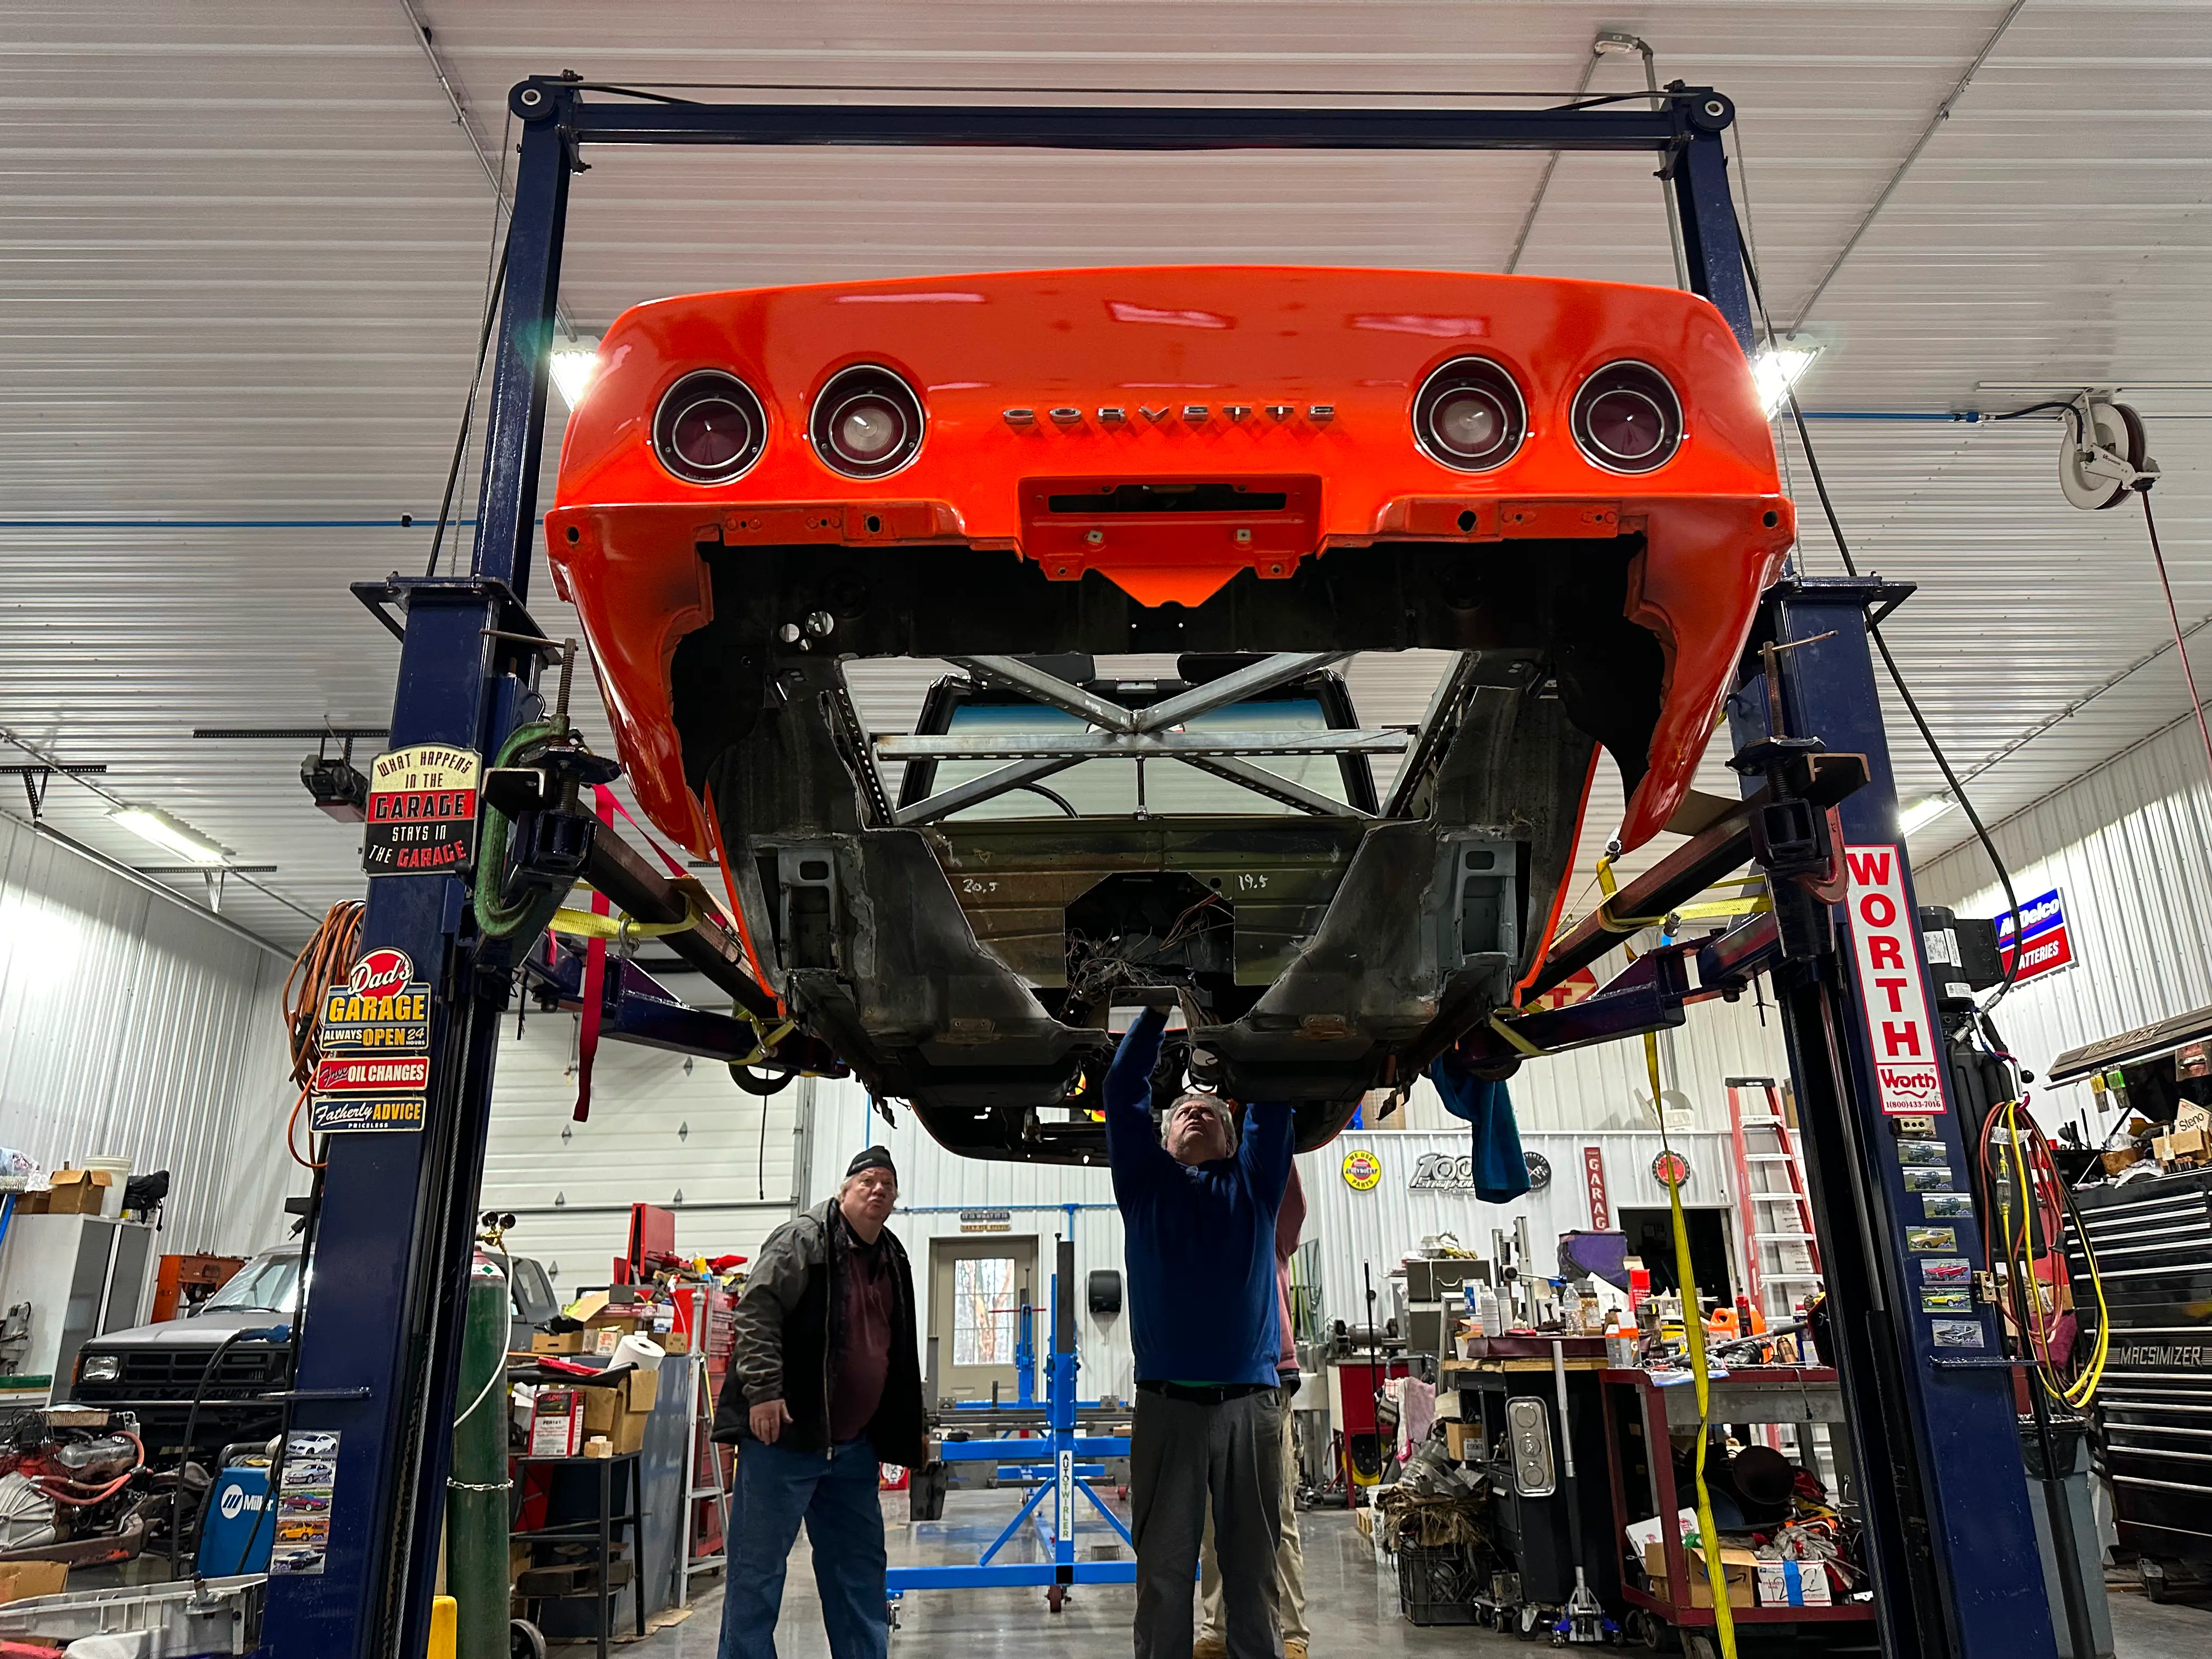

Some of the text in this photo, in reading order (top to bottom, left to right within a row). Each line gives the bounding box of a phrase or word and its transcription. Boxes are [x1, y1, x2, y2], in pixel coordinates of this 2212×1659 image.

[1003, 404, 1335, 424] CORVETTE
[377, 751, 473, 777] WHAT HAPPENS
[405, 773, 443, 788] IN THE
[375, 793, 465, 819] GARAGE
[392, 825, 446, 842] STAYS IN
[369, 840, 466, 867] THE GARAGE
[963, 879, 998, 893] 20.5
[1238, 874, 1268, 890] 19.5
[1847, 853, 1921, 1057] WORTH
[2018, 940, 2059, 970] ATTERIES
[347, 957, 413, 995] Dad's
[329, 995, 426, 1022] GARAGE
[324, 1028, 424, 1046] ALWAYS OPEN 24
[320, 1064, 424, 1087] Free OIL CHANGES
[1880, 1069, 1936, 1090] Worth
[316, 1102, 420, 1126] Fatherly ADVICE
[2179, 1113, 2204, 1131] Steno
[1361, 1153, 1373, 1161] USE
[1352, 1179, 1373, 1188] PARTS
[1588, 1158, 1606, 1229] GARAG
[2120, 1346, 2202, 1367] MACSIMIZER
[243, 1494, 273, 1511] Millr
[1061, 1454, 1070, 1538] AUTOTWIRLER
